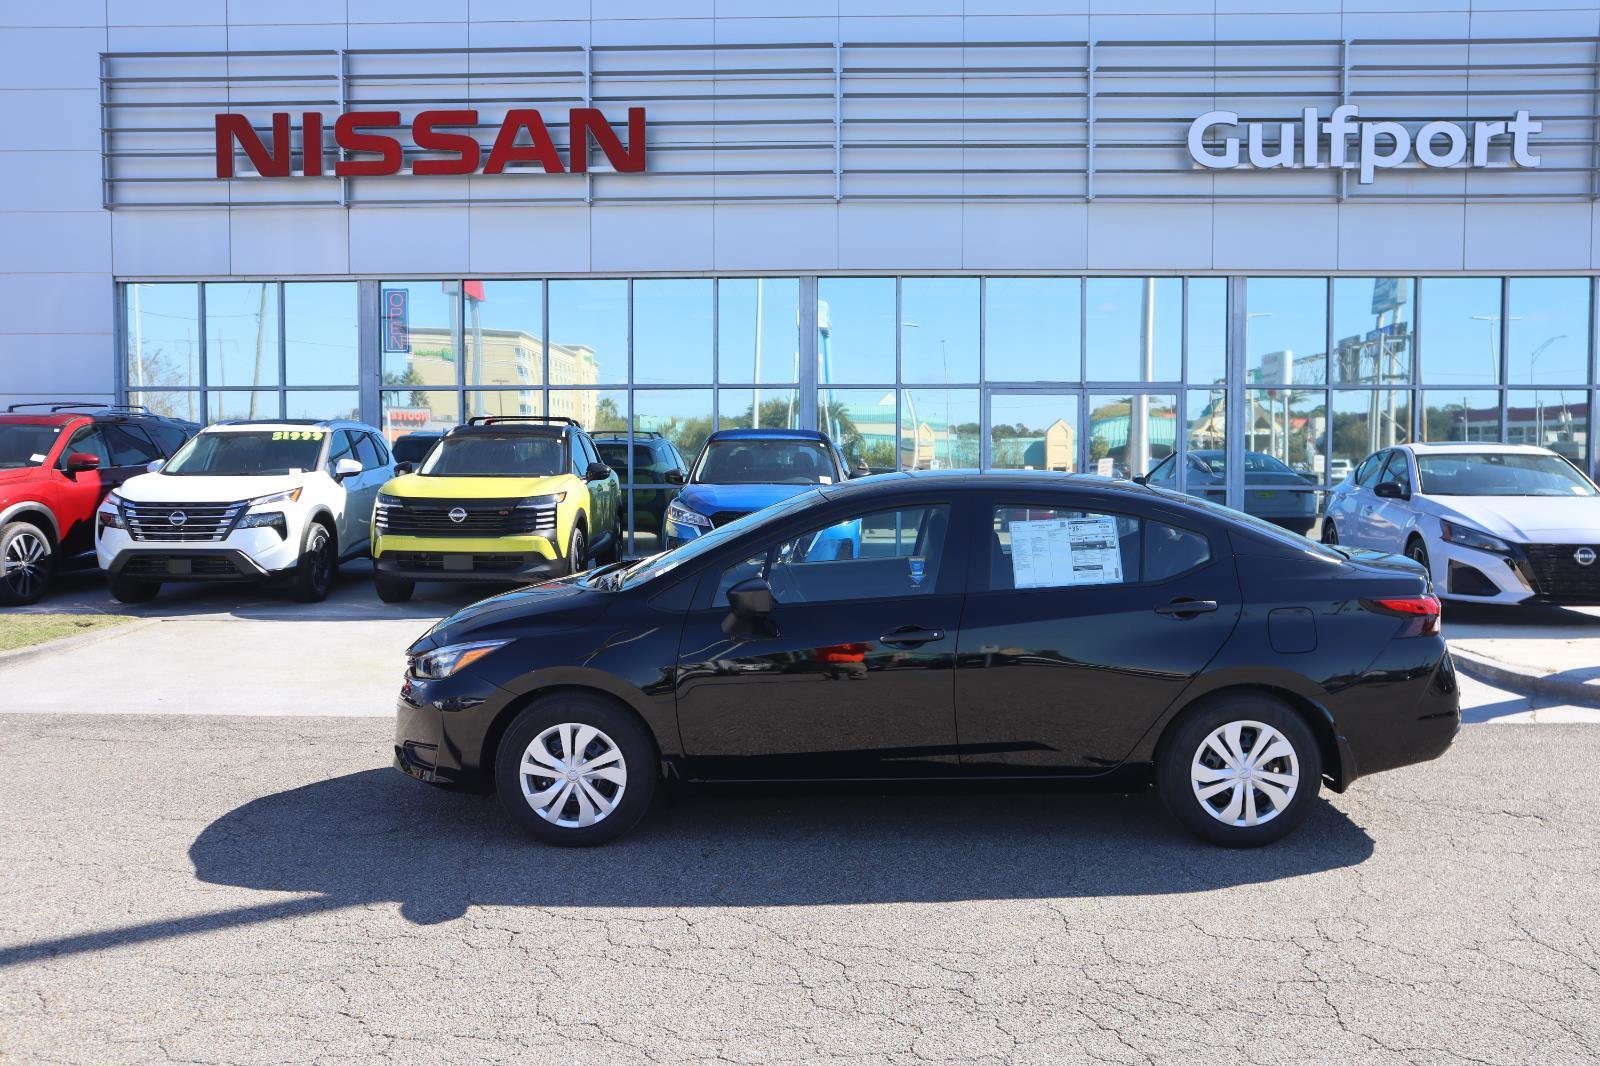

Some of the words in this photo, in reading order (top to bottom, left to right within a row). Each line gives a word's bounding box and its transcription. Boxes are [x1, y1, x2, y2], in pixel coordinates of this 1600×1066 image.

[215, 107, 646, 178] NISSAN
[1187, 104, 1543, 184] Gulfport
[389, 293, 404, 350] OPEN
[271, 431, 323, 441] 31999
